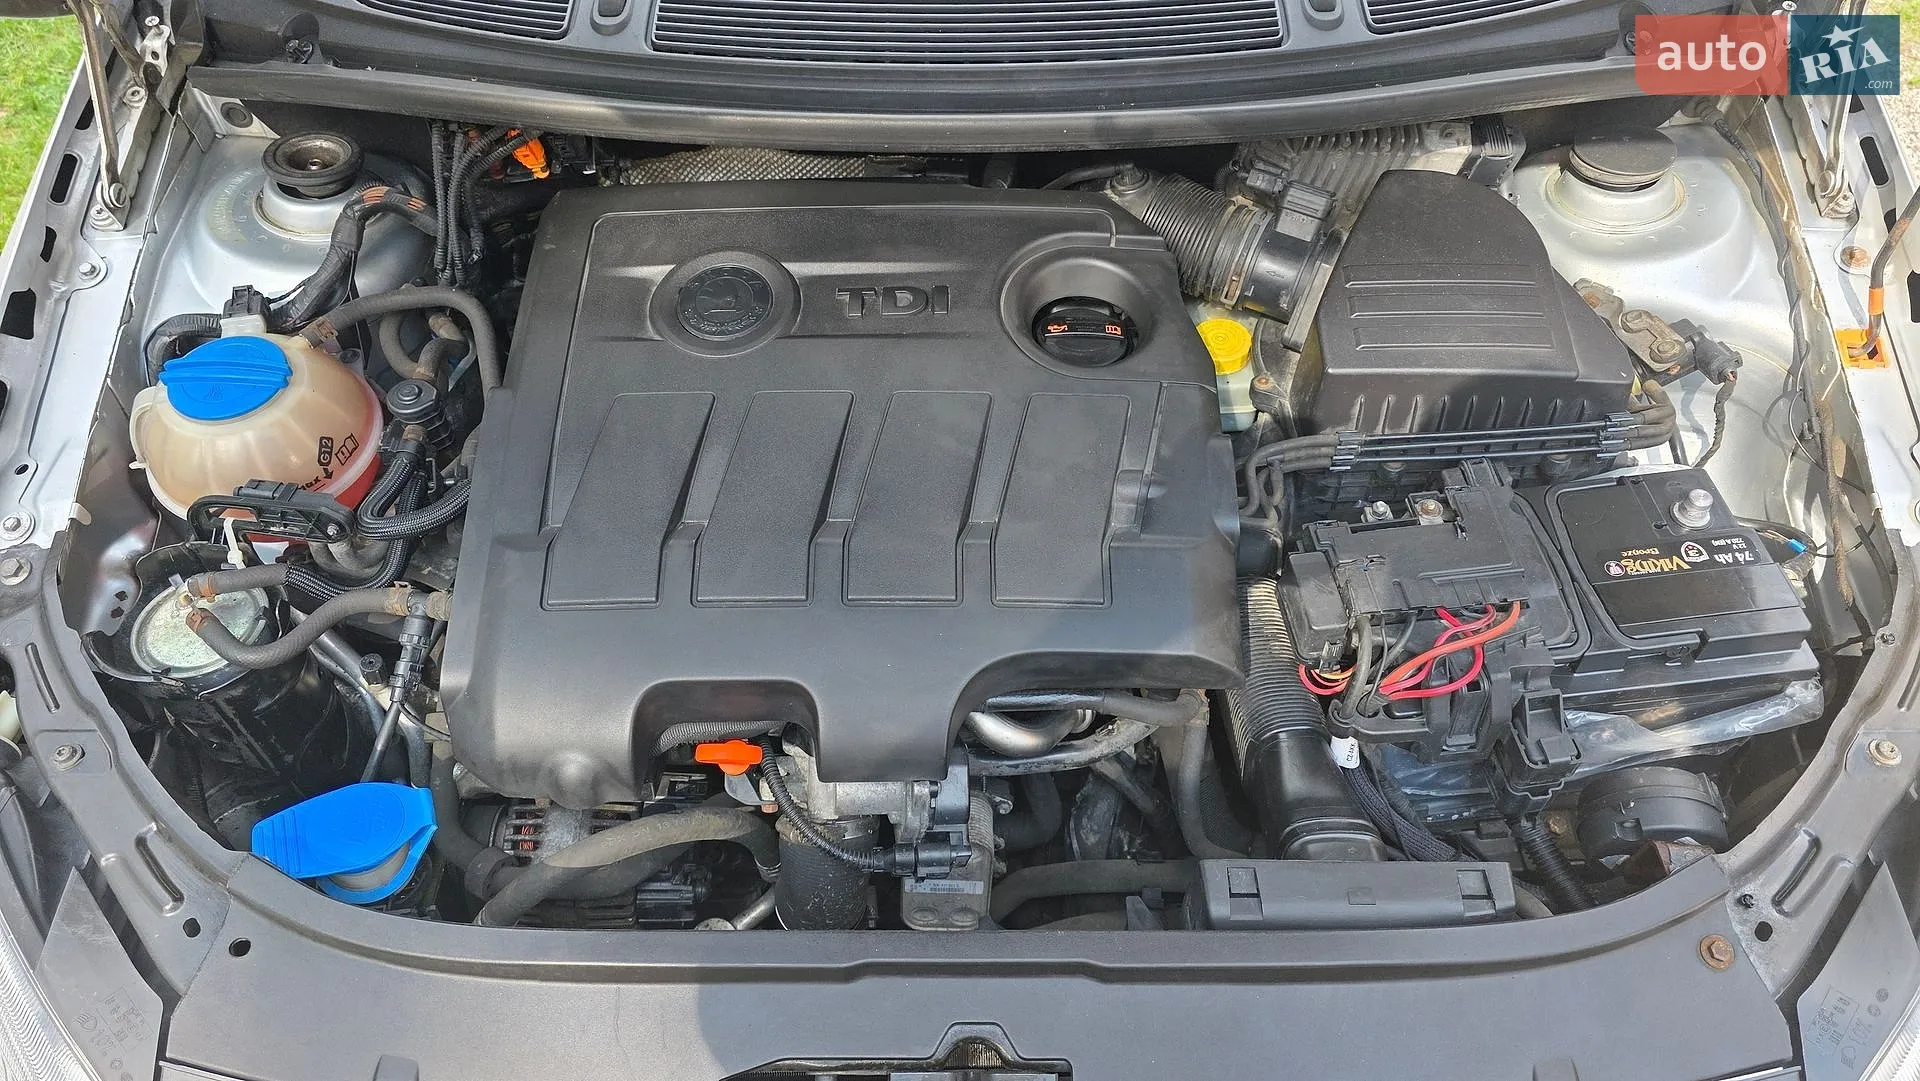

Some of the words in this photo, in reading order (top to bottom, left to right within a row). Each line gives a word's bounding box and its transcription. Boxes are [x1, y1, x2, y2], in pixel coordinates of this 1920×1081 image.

[836, 285, 950, 319] TDI
[320, 438, 333, 464] G12
[1621, 548, 1660, 557] Bronze
[1713, 552, 1734, 565] Ah
[1735, 551, 1754, 565] 74
